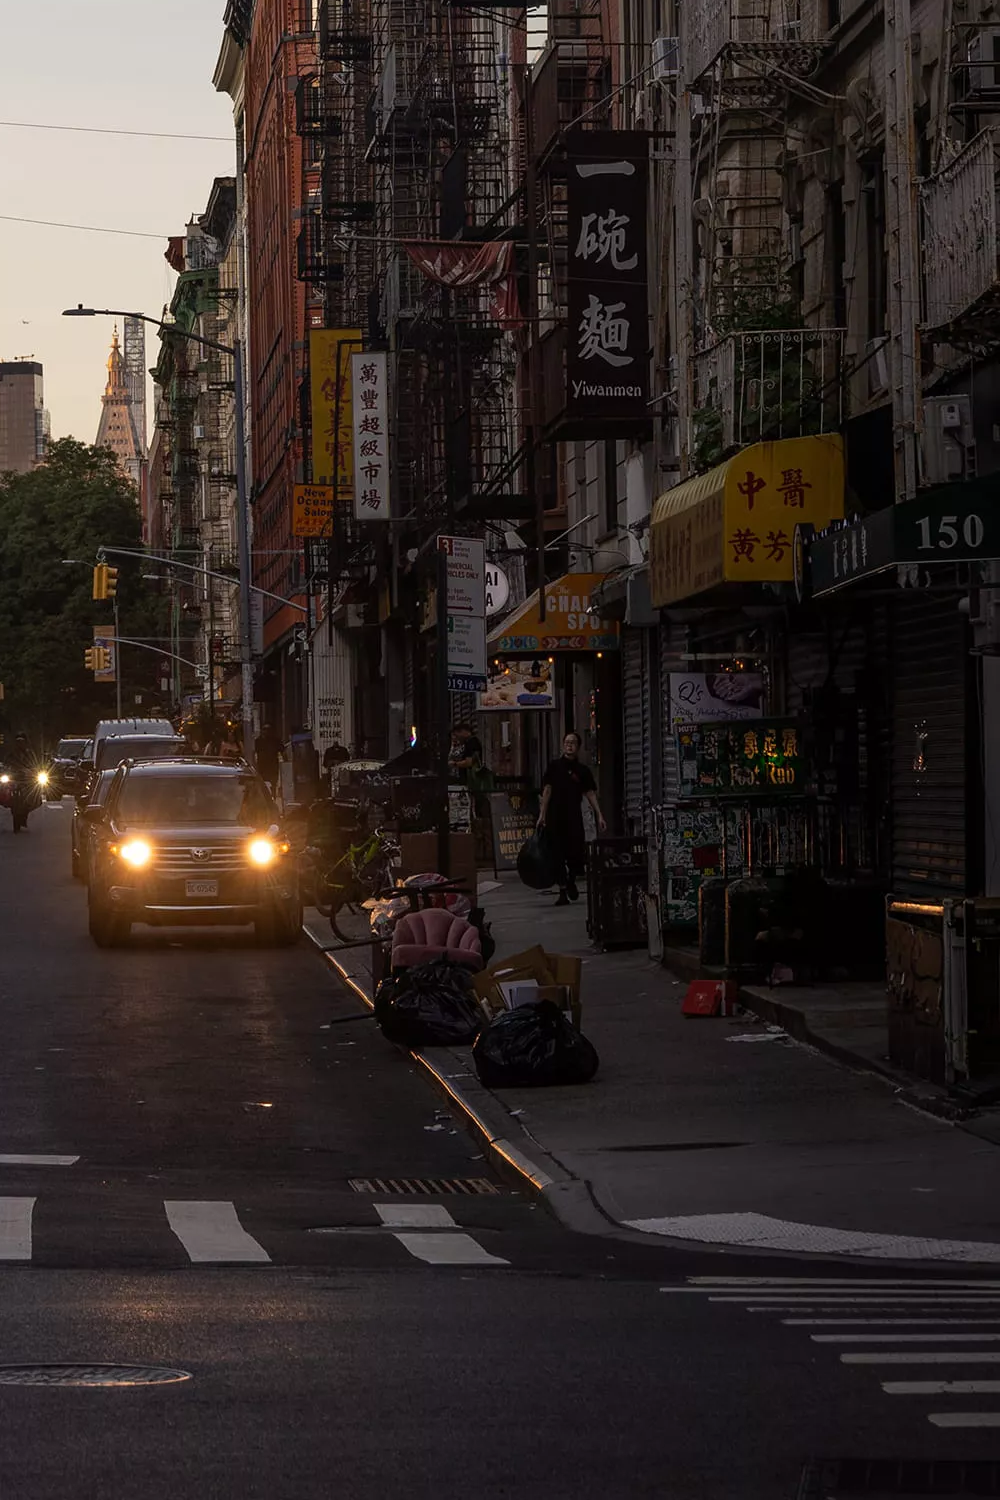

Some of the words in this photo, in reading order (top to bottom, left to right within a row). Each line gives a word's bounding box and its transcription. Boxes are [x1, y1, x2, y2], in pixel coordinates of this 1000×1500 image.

[575, 160, 638, 368] 一碗麵
[572, 379, 641, 399] Yiwanmen
[358, 362, 383, 510] 萬豐超級市場
[304, 488, 326, 497] New
[737, 468, 812, 510] 中醫
[915, 513, 984, 550] 150
[678, 680, 704, 705] Q's
